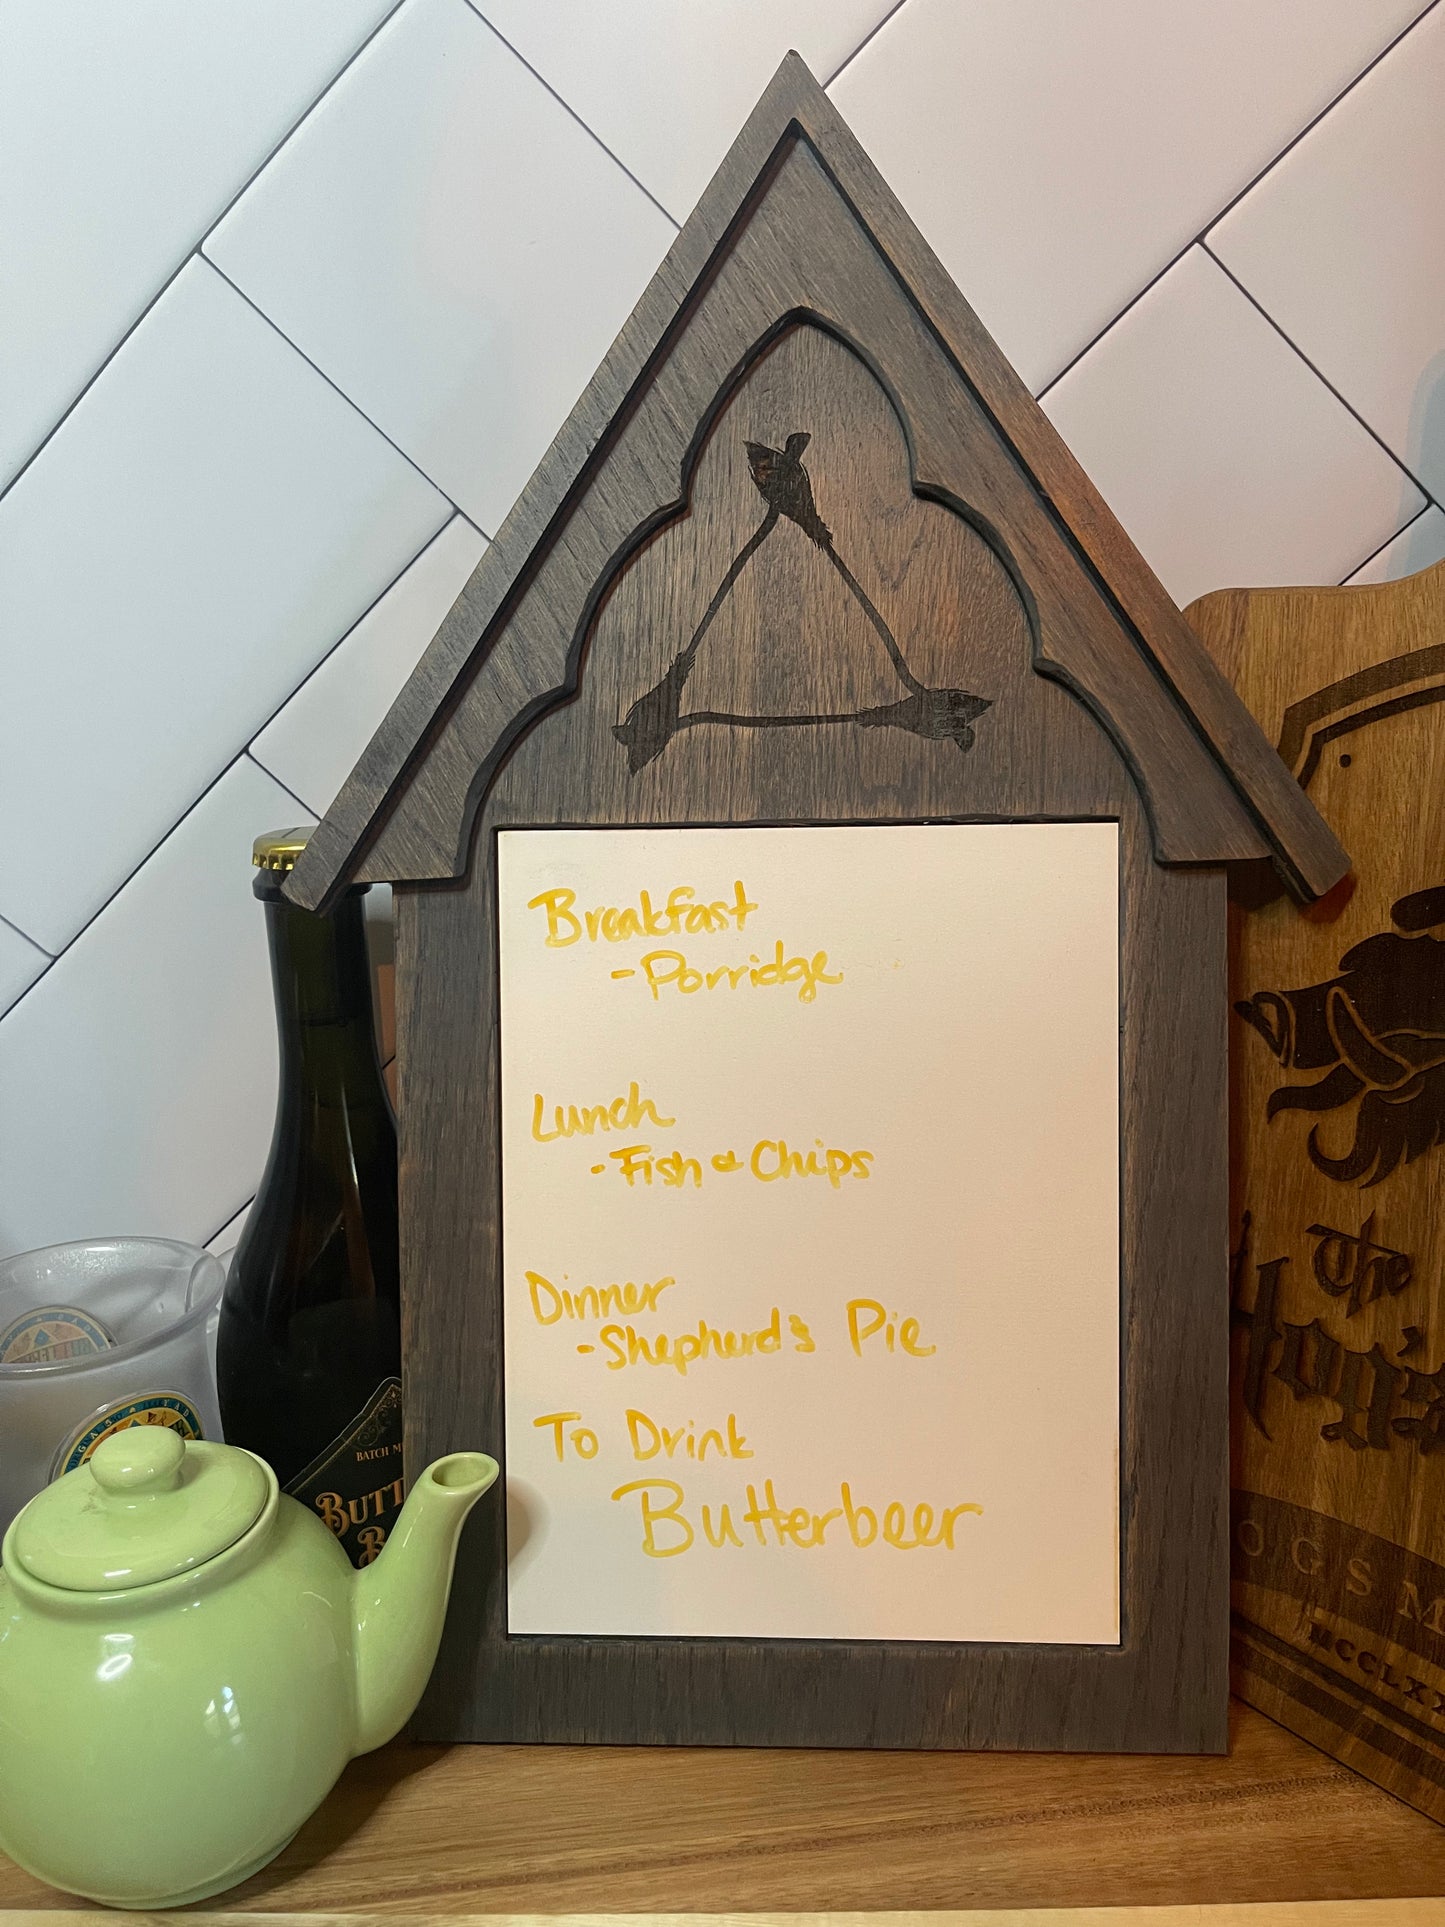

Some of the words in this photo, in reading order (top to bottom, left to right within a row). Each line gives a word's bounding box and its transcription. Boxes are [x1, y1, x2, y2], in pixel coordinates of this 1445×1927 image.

[528, 880, 759, 947] Breakfast
[532, 1082, 676, 1141] Lunch
[751, 1140, 873, 1188] Chips
[525, 1271, 675, 1325] Dinner
[847, 1299, 936, 1356] Pie
[355, 1446, 390, 1462] BATCH
[533, 1412, 598, 1460] To
[626, 1409, 753, 1460] Drink
[612, 1479, 983, 1557] Butterbeer
[1237, 1518, 1445, 1637] OGSM
